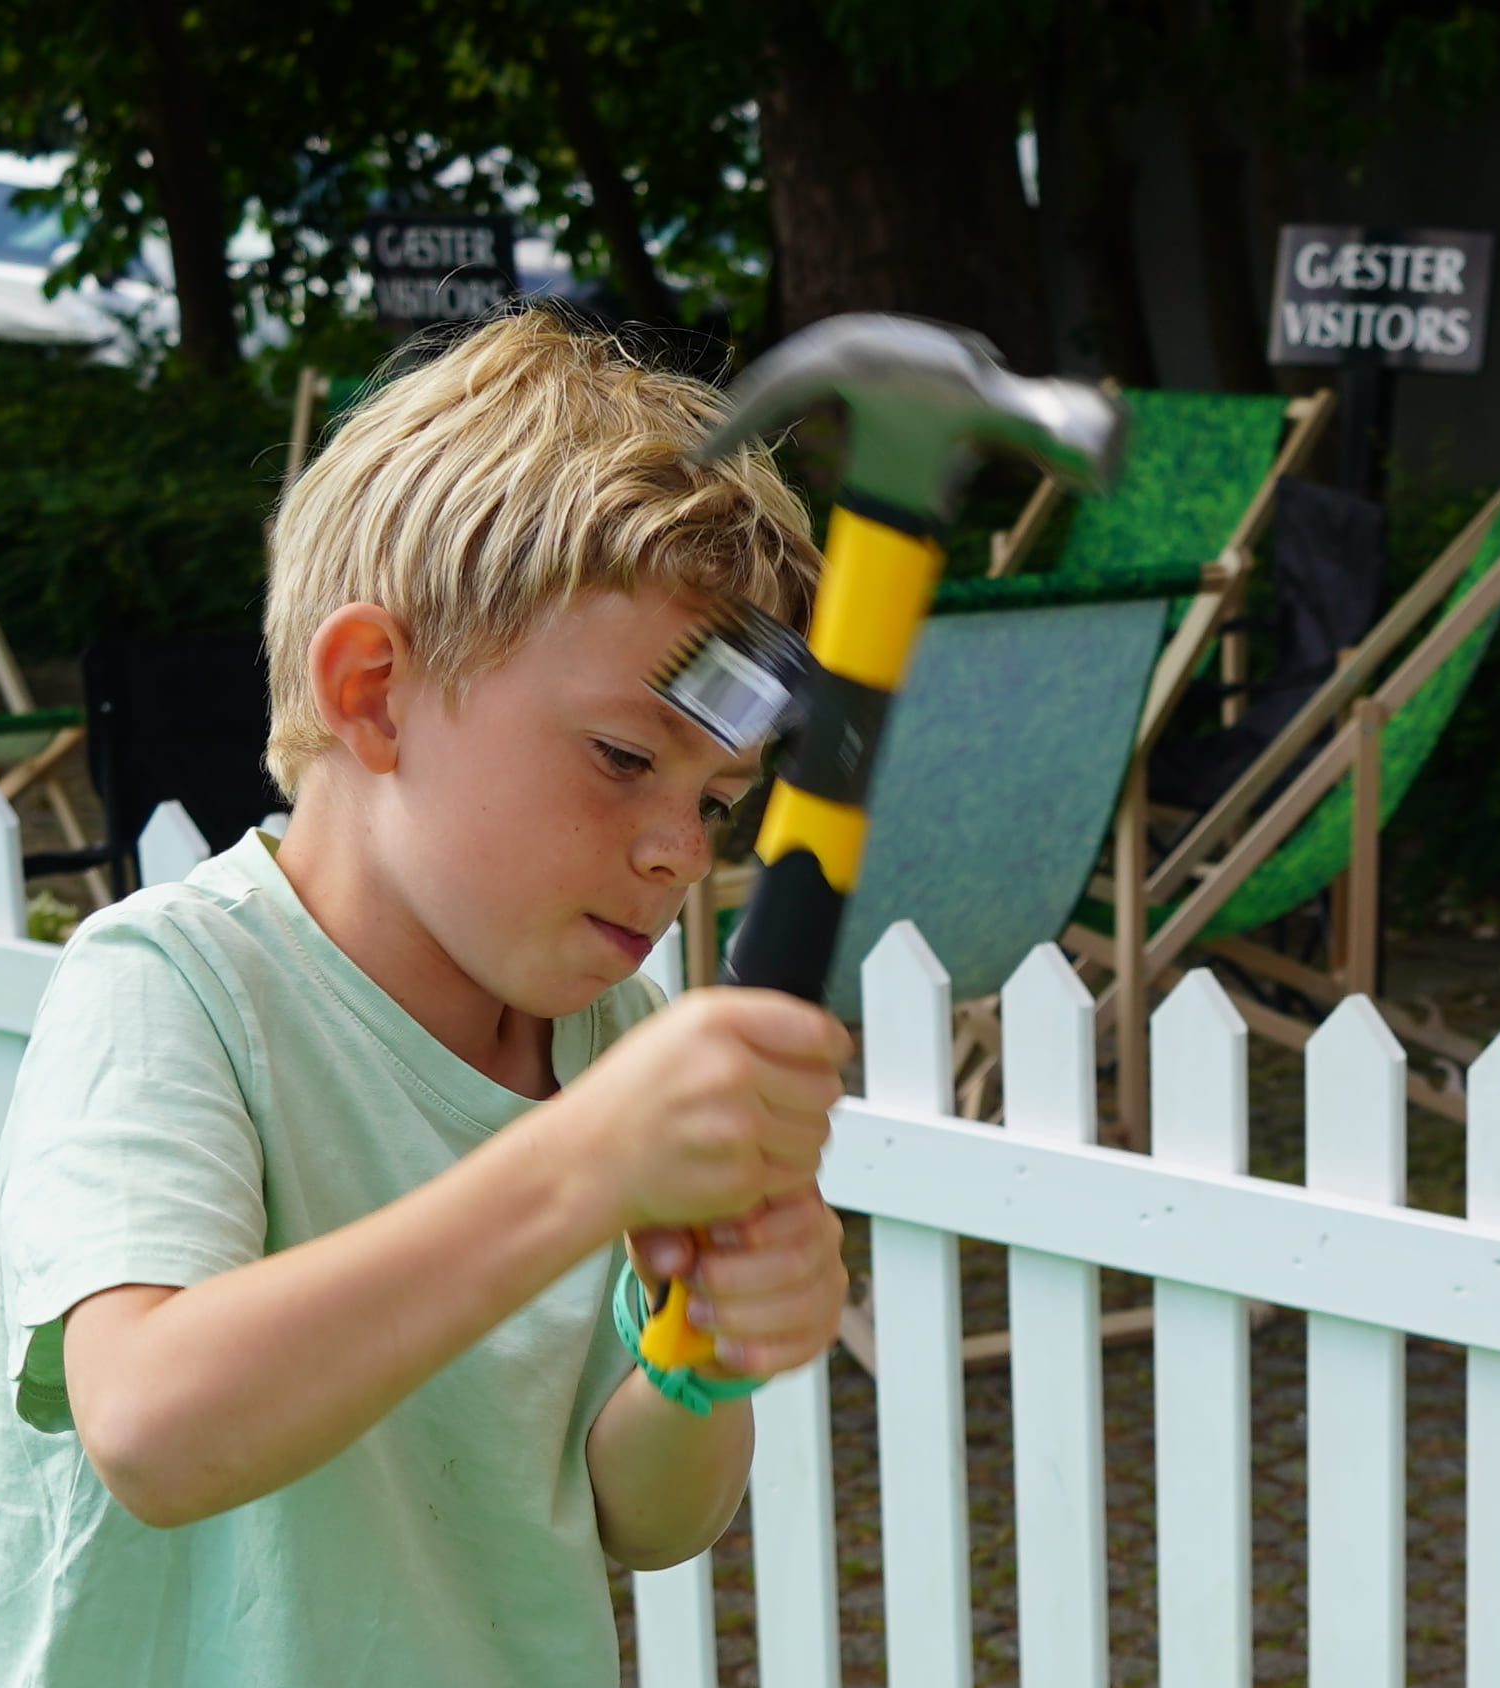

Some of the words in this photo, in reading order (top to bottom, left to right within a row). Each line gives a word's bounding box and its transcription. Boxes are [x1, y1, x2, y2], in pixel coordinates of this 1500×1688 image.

[376, 224, 496, 267] GÆSTER
[1294, 241, 1466, 294] GÆSTER
[1282, 302, 1472, 355] VISITORS
